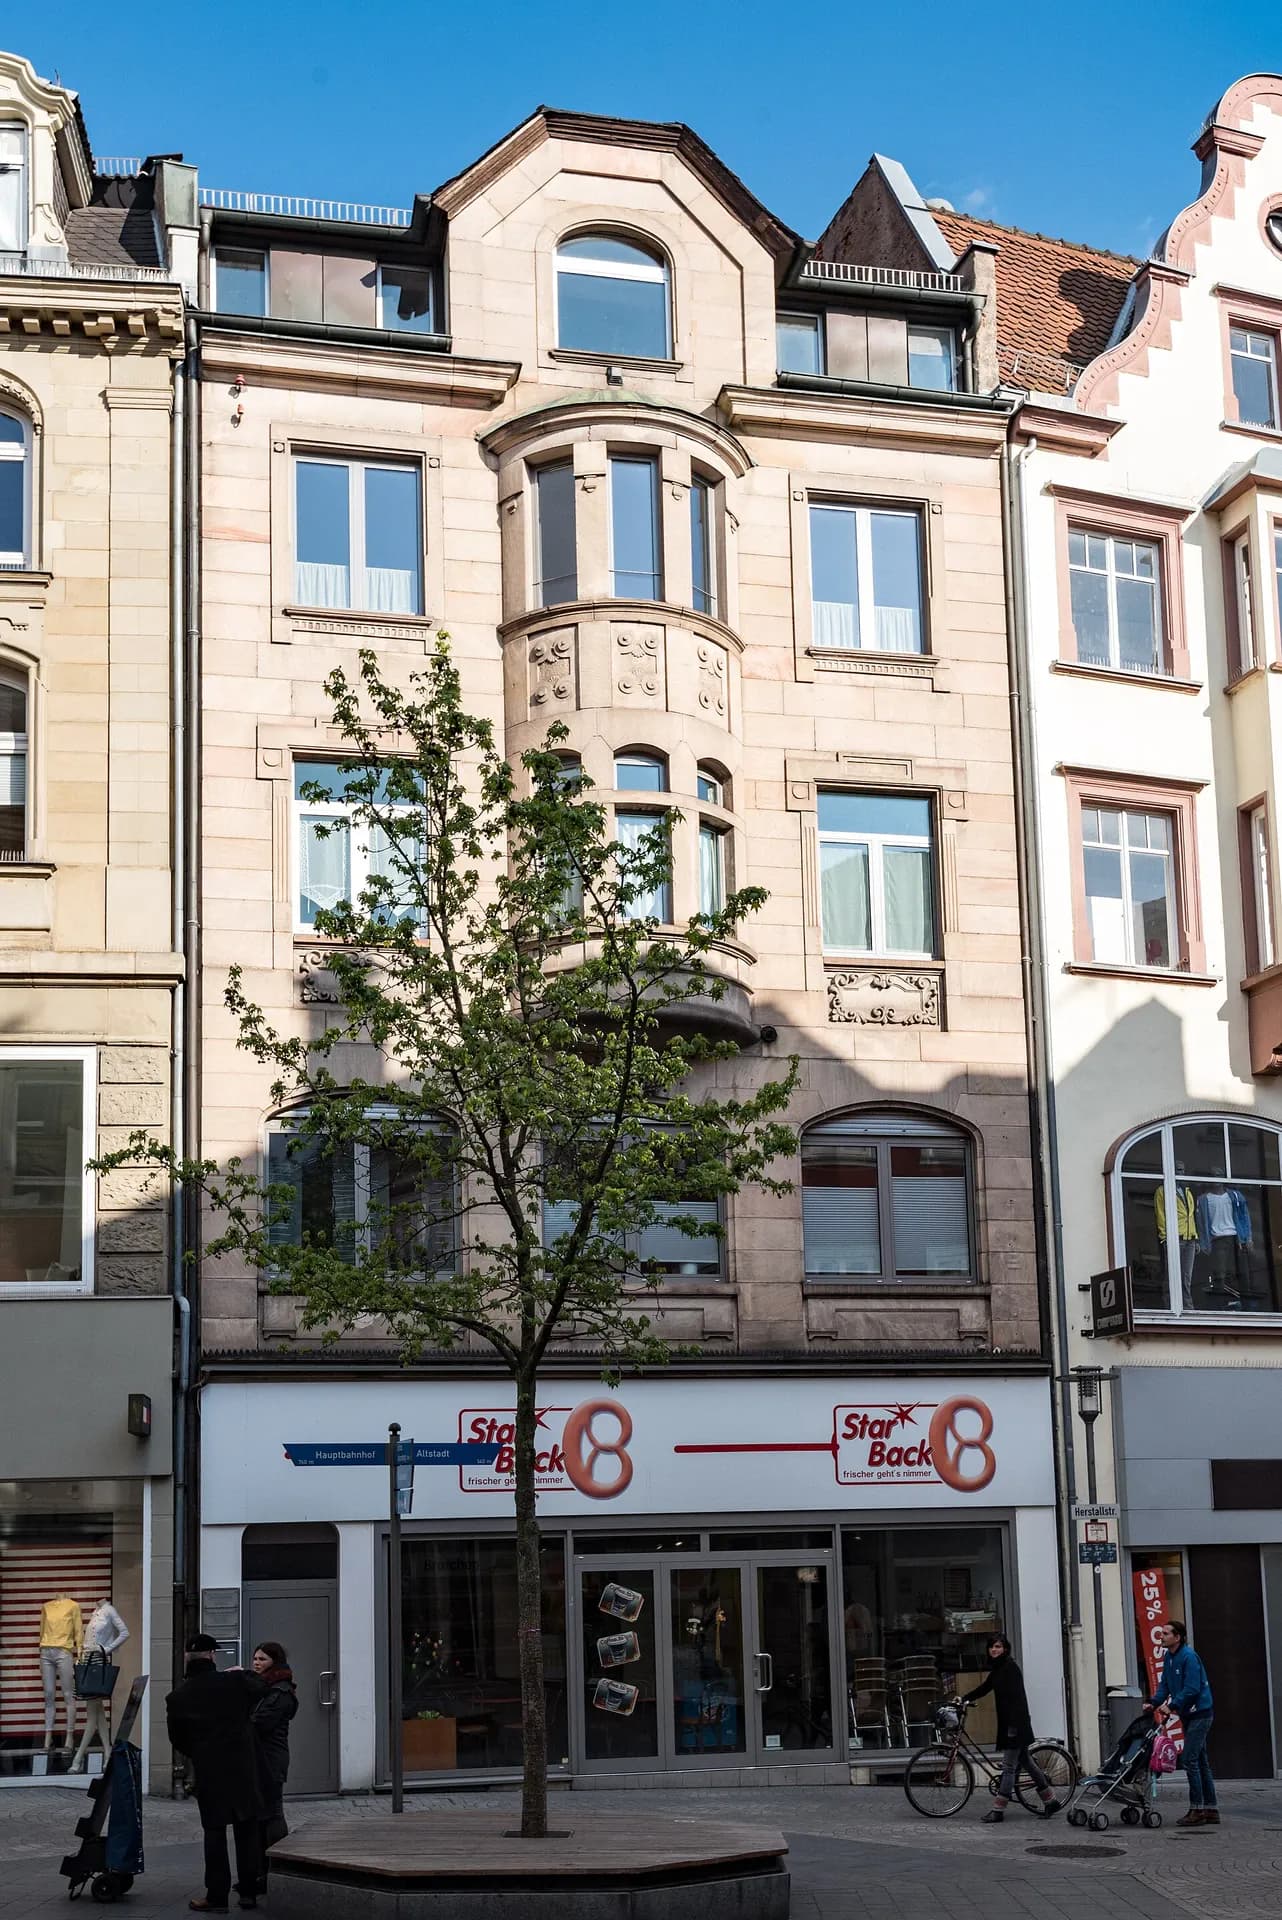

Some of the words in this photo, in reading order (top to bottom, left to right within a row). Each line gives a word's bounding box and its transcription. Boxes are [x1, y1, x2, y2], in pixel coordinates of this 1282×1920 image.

[467, 1417, 516, 1444] Sta
[841, 1413, 899, 1440] Star
[315, 1450, 376, 1461] Hauptbahnhof
[416, 1449, 450, 1458] Altstadt
[495, 1443, 567, 1473] Bck
[867, 1438, 934, 1467] Back
[468, 1476, 502, 1485] frischer
[843, 1469, 874, 1478] frischer
[903, 1469, 932, 1477] nimmer
[1074, 1506, 1118, 1517] Herstallstr.
[1140, 1571, 1163, 1621] 25%
